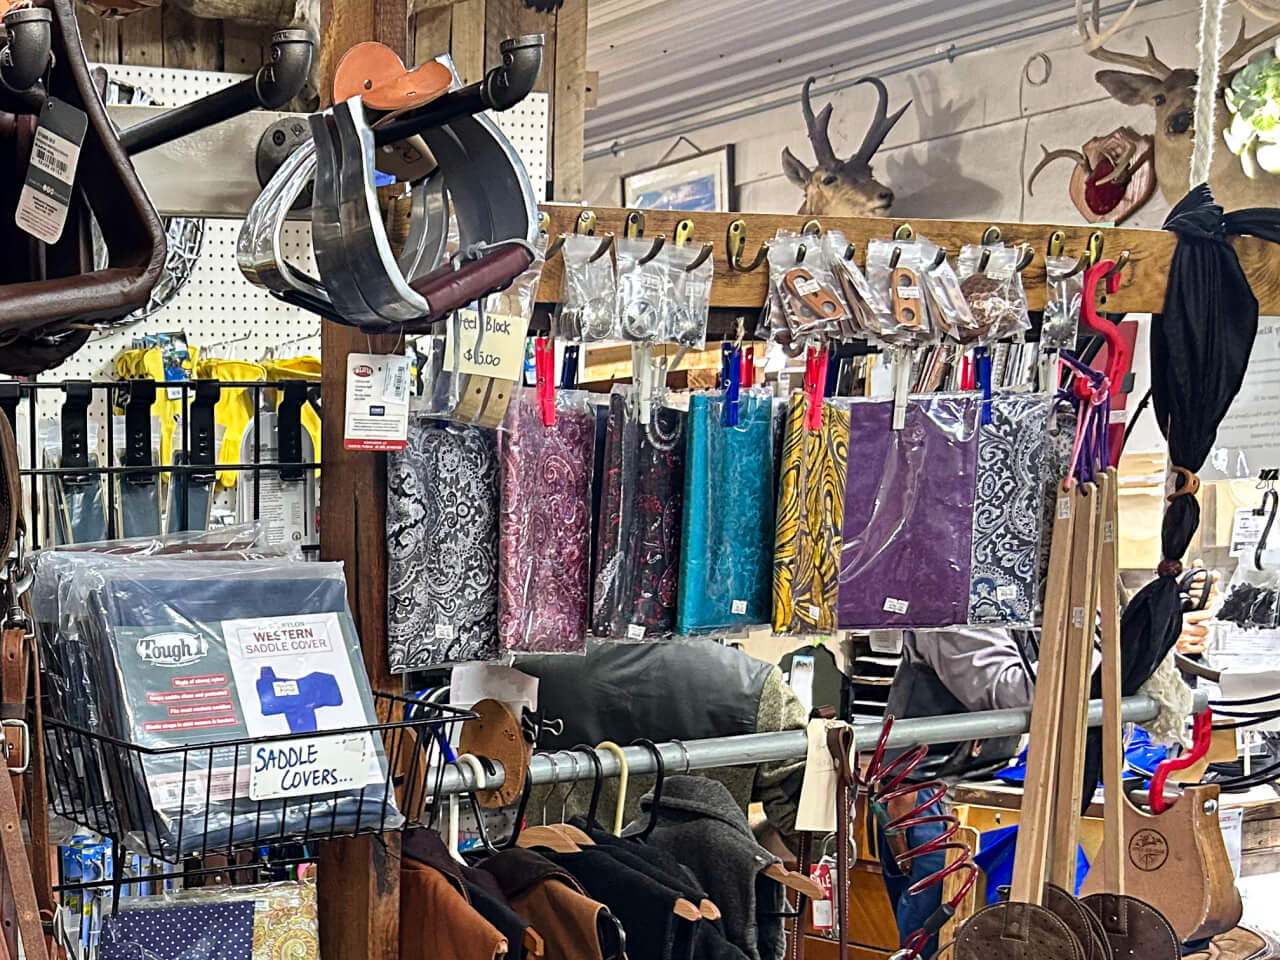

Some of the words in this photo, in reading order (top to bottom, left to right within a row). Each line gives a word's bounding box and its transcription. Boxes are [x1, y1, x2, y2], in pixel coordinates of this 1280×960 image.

[253, 627, 314, 643] WESTERN
[245, 642, 289, 655] SADDLE
[290, 638, 328, 652] COVER
[255, 745, 318, 773] SADDLE
